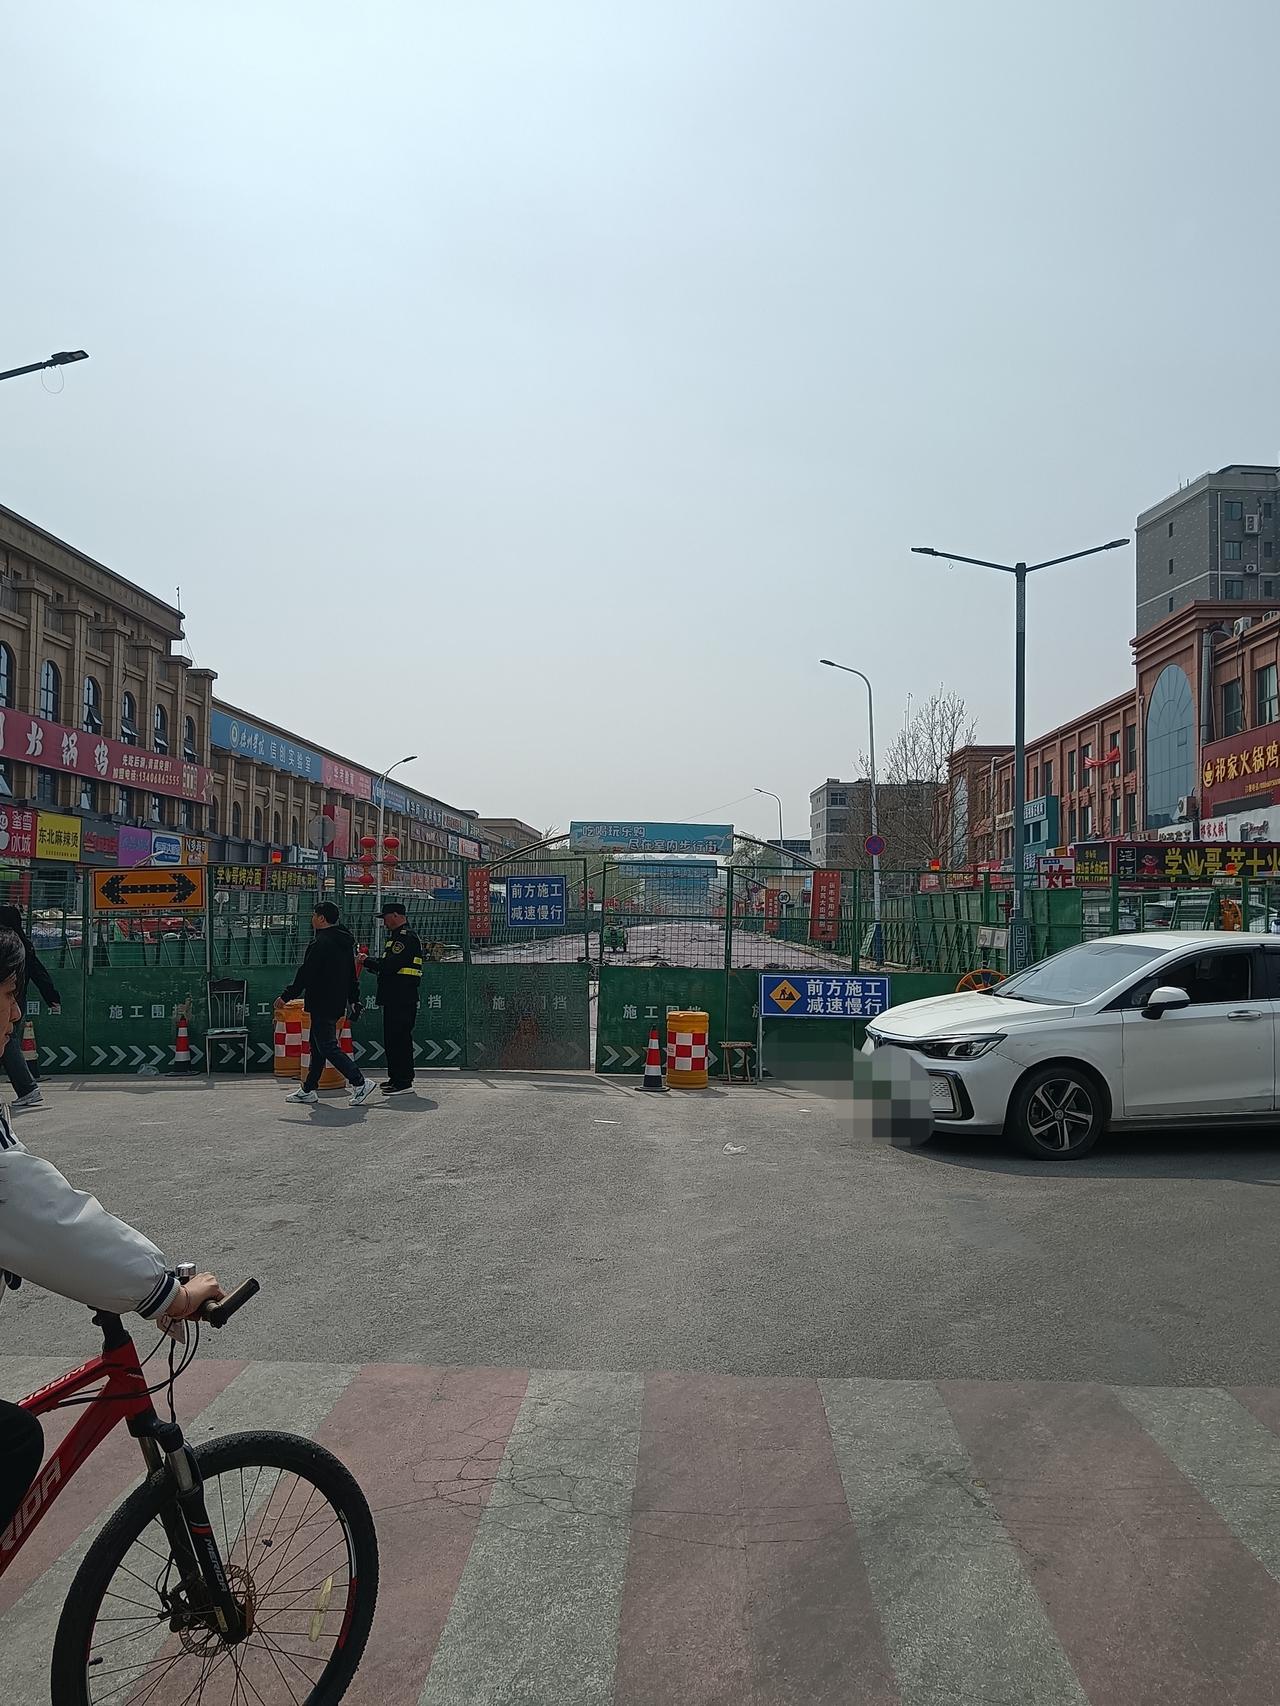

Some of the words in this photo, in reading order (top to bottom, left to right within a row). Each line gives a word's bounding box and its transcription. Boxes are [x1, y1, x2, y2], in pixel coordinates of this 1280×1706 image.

[39, 827, 79, 848] 东北麻辣烫
[582, 825, 645, 837] 吃喝玩乐购
[628, 838, 717, 852] 尽在室内步行街
[510, 883, 562, 898] 前方施工
[510, 905, 562, 920] 减速慢行
[806, 979, 882, 997] 前方施工
[806, 998, 882, 1014] 减速慢行
[204, 1538, 229, 1592] MERIDA
